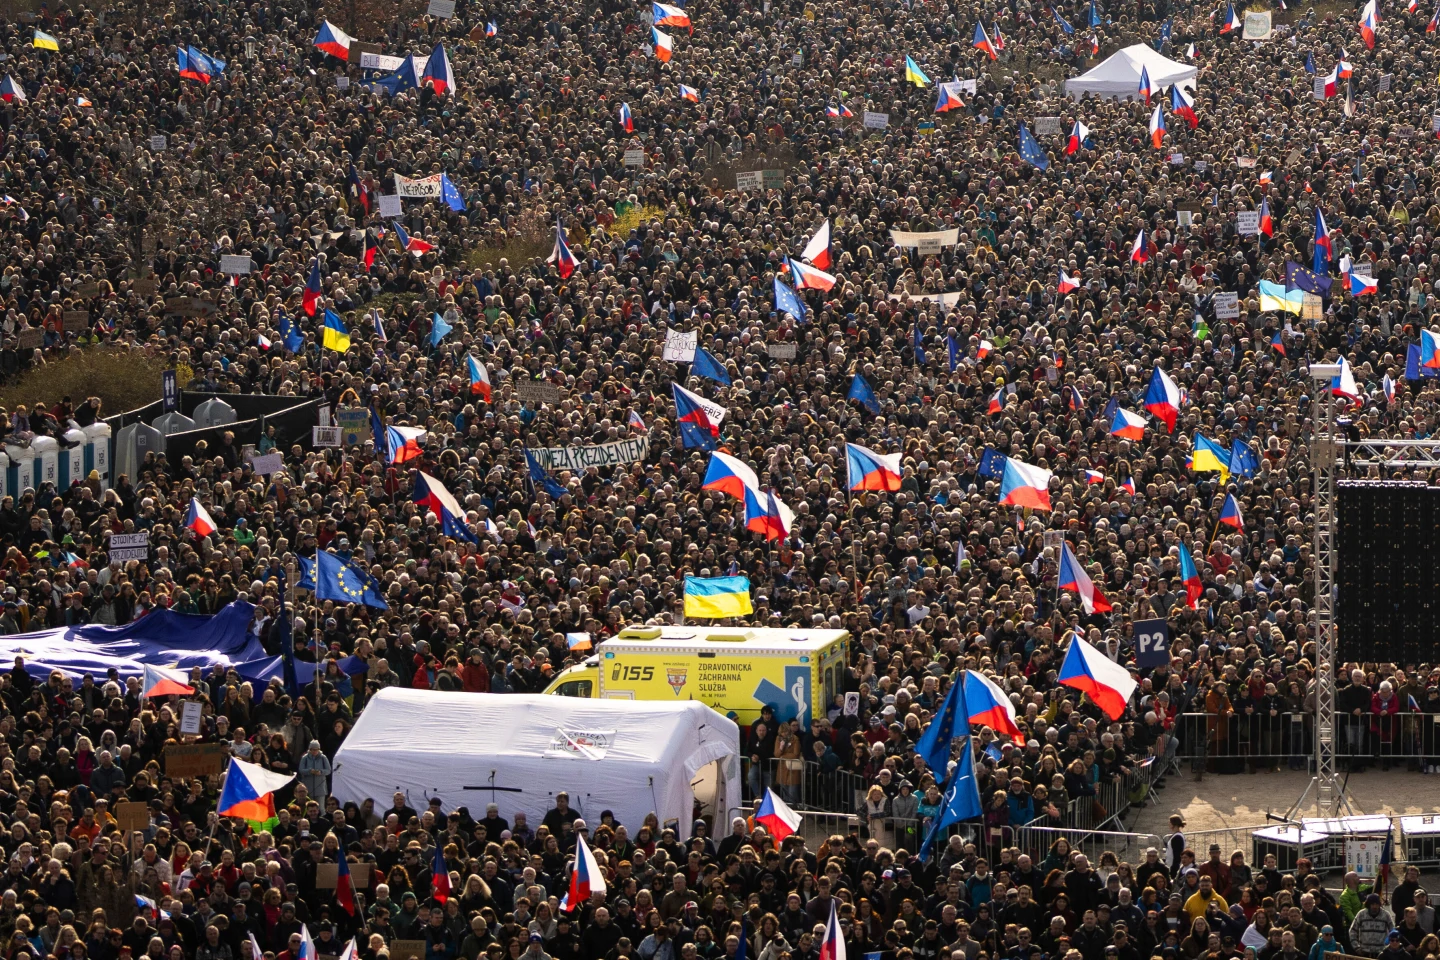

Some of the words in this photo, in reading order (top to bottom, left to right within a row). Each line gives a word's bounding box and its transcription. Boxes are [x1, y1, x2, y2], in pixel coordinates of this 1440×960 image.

[167, 397, 174, 405] WC
[572, 437, 647, 469] PREZIDENTEM
[1139, 632, 1165, 652] P2
[698, 661, 752, 672] ZDRAVOTNICKÁ
[623, 666, 655, 681] 155
[698, 672, 742, 682] ZÁCHRANNÁ
[699, 682, 727, 692] SLUŽBA
